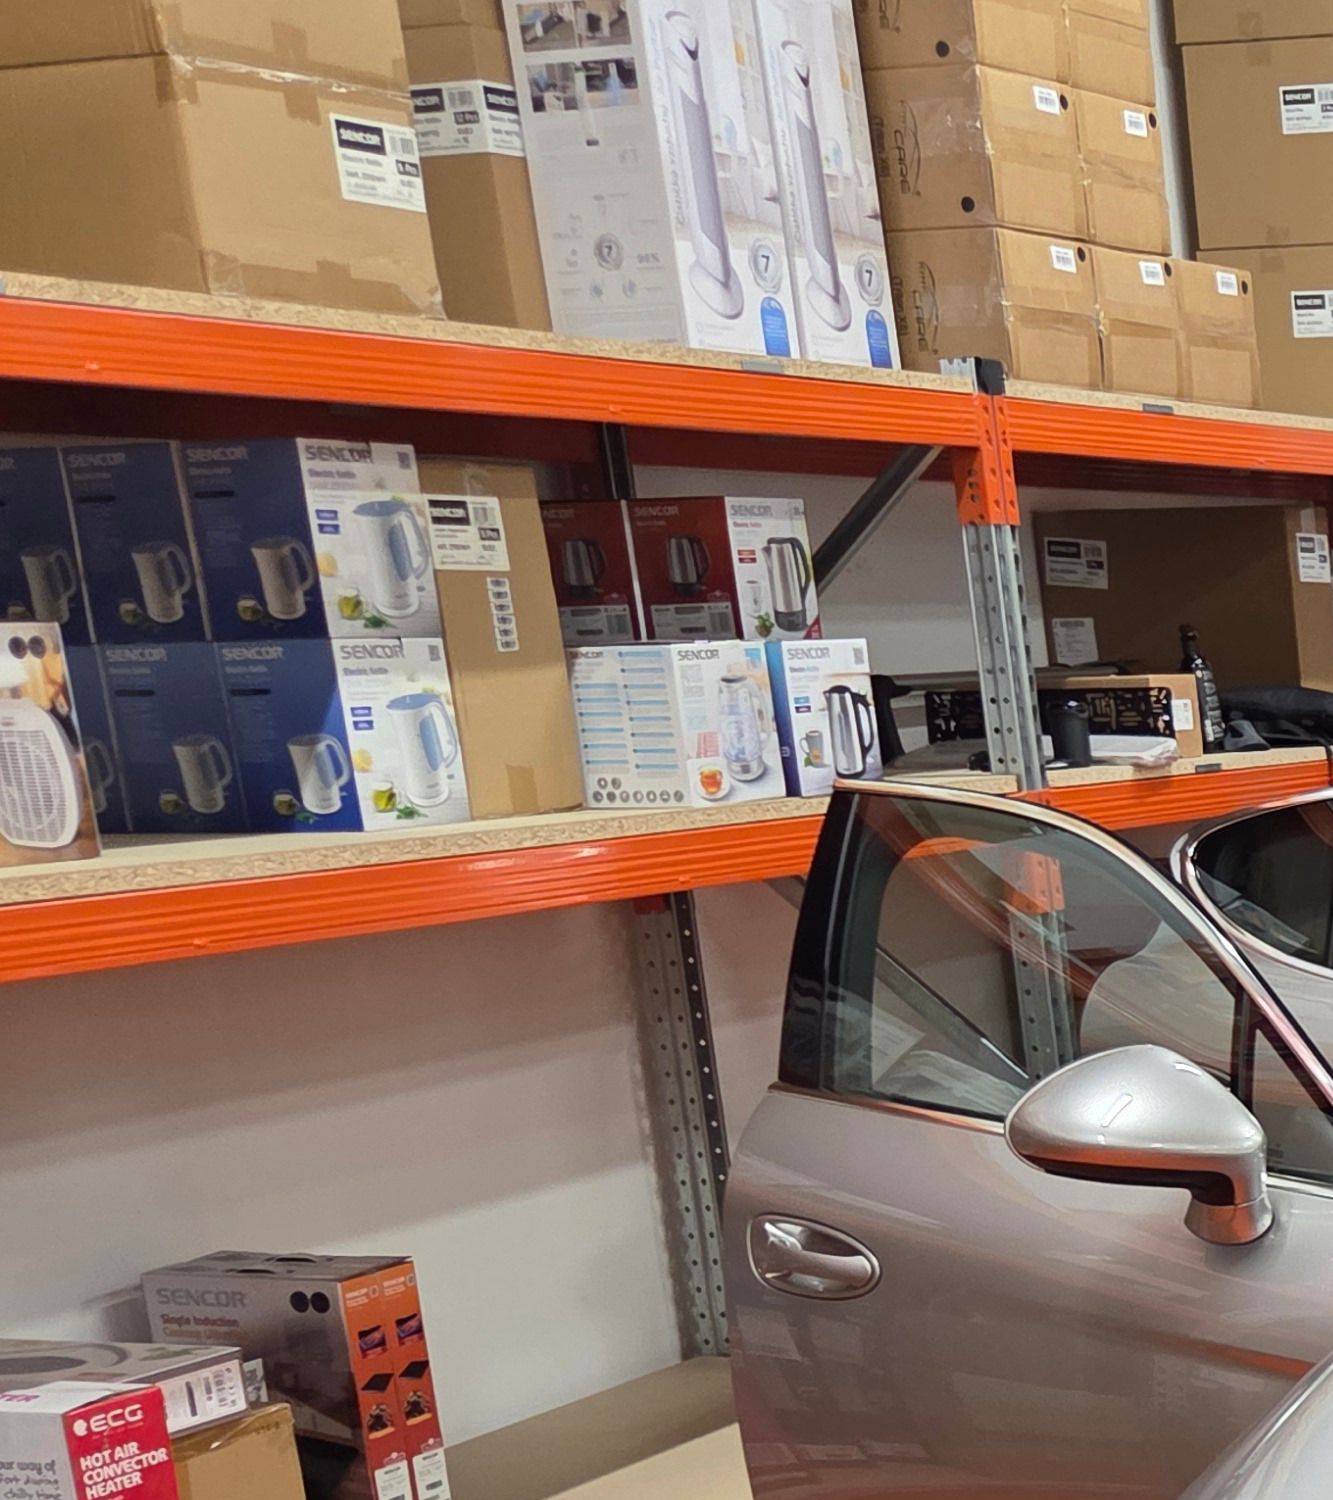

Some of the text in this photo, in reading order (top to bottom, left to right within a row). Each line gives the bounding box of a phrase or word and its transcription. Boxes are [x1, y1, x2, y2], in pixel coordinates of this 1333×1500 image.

[186, 446, 248, 463] SENCOR
[304, 444, 374, 464] SENCOR
[543, 508, 575, 520] NCOR
[634, 505, 680, 517] SENCOR
[730, 504, 773, 517] SENCOR
[106, 646, 168, 663] SENCOR
[222, 644, 285, 662] SENCOR
[340, 642, 406, 660] SENCOR
[677, 648, 720, 662] SENCOR
[787, 647, 831, 660] SENCOR
[156, 1288, 246, 1309] SENCOR
[90, 1404, 144, 1432] ECG
[80, 1442, 141, 1471] HOT AIR
[83, 1448, 169, 1485] CONVECTOR
[85, 1472, 143, 1500] HEATER
